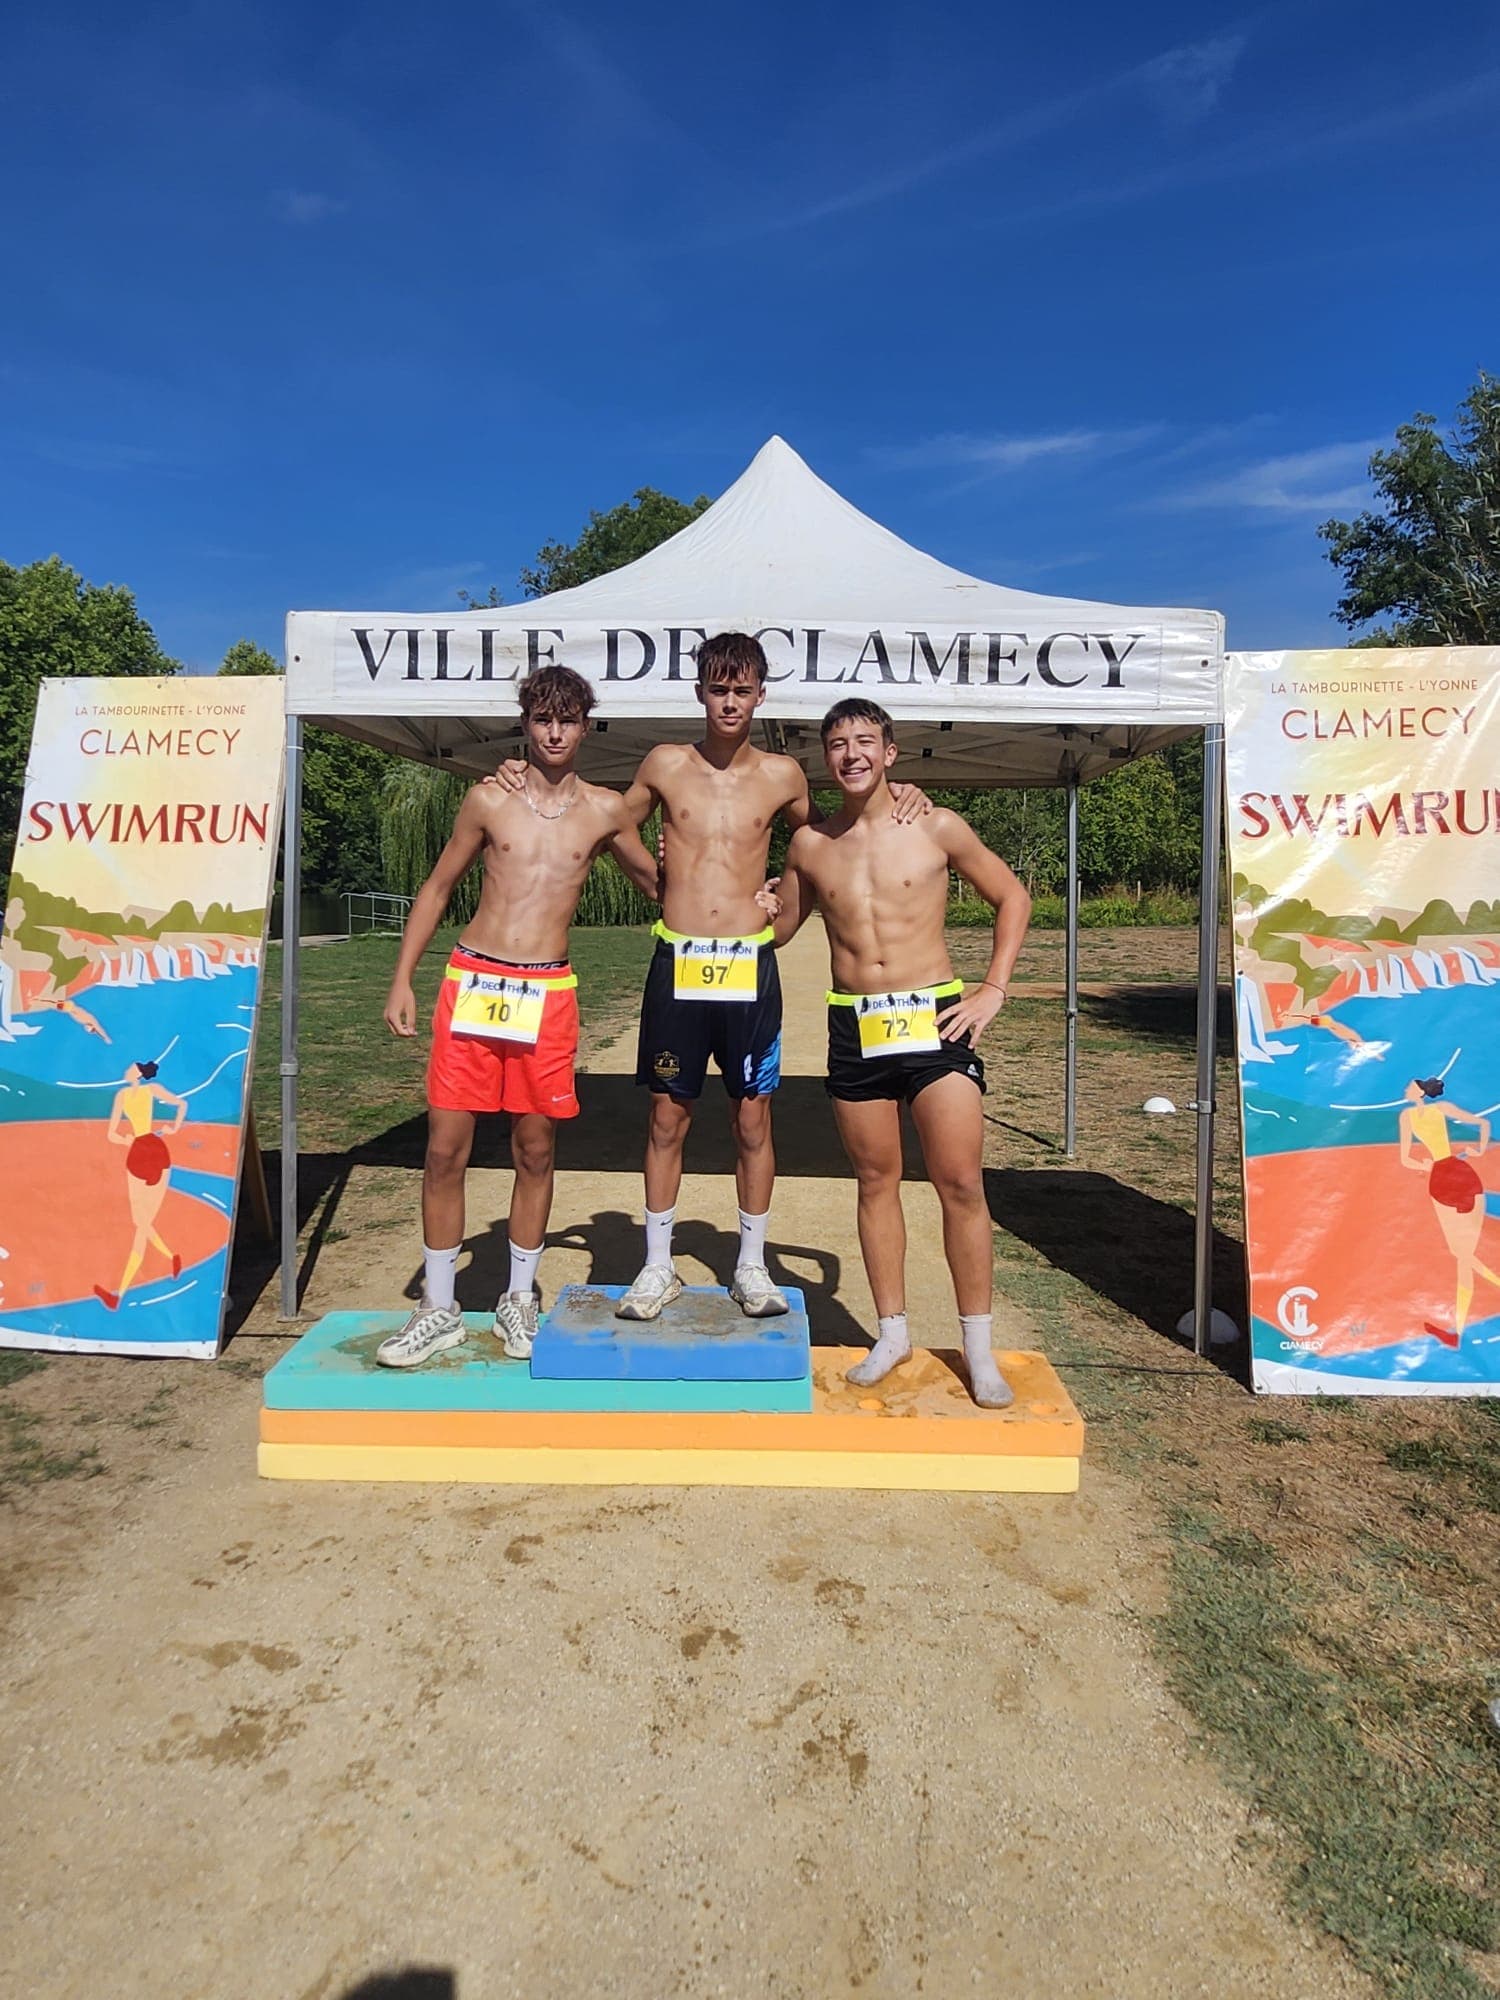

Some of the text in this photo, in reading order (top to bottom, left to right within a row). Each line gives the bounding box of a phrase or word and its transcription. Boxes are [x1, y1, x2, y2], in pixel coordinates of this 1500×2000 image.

[350, 627, 1147, 689] VILLE DE CLAMECY
[1271, 682, 1287, 694] LA
[1293, 681, 1404, 694] TAMBOURINETTE
[1419, 679, 1479, 691] L'YONNE
[74, 704, 88, 716] LA
[93, 704, 185, 717] TAMBOURINETTE
[196, 704, 247, 716] L'YONNE
[1281, 705, 1476, 740] CLAMECY
[80, 729, 241, 756] CLAMECY
[27, 801, 270, 843] SWIMRUN
[1238, 788, 1500, 839] SWIMRU
[702, 965, 728, 985] 97
[486, 1002, 511, 1022] 10
[881, 1018, 911, 1039] 72
